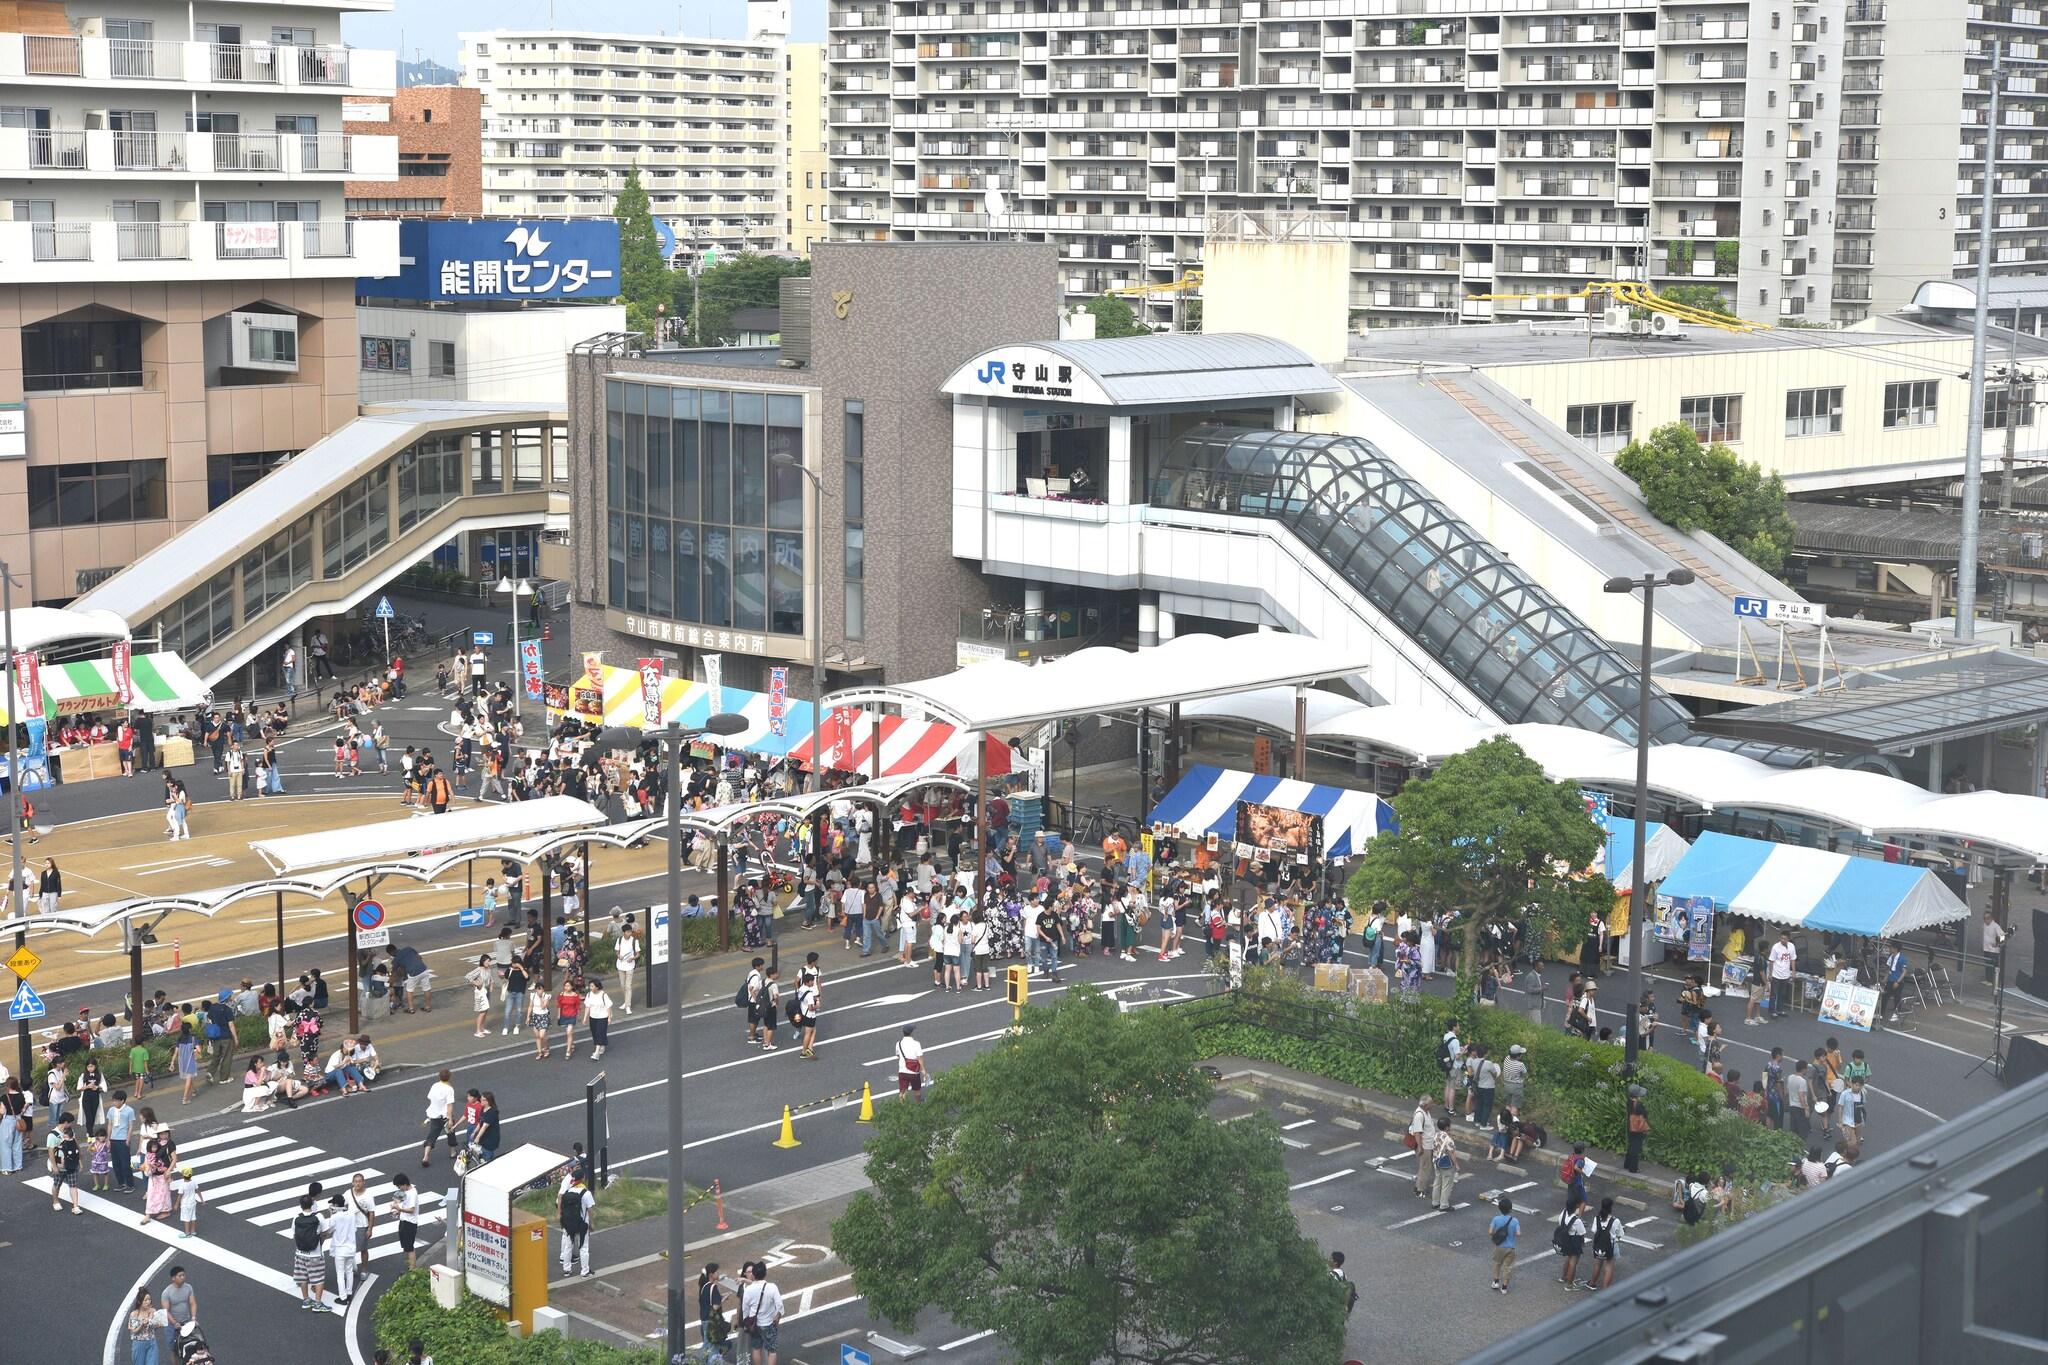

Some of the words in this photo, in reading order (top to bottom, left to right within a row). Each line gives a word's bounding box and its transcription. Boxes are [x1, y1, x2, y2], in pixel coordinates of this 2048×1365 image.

[1938, 207, 1946, 220] 3
[440, 259, 613, 295] 能開センター
[978, 361, 1006, 385] JR
[1012, 363, 1072, 383] 守山駅
[1046, 387, 1072, 397] STATION
[1740, 600, 1762, 616] JR
[1779, 603, 1811, 615] 守山駅
[626, 615, 765, 654] 守山市駅前総合案内所
[523, 643, 543, 694] かき氷
[833, 713, 845, 761] ラーメン
[471, 1215, 501, 1233] お知らせ
